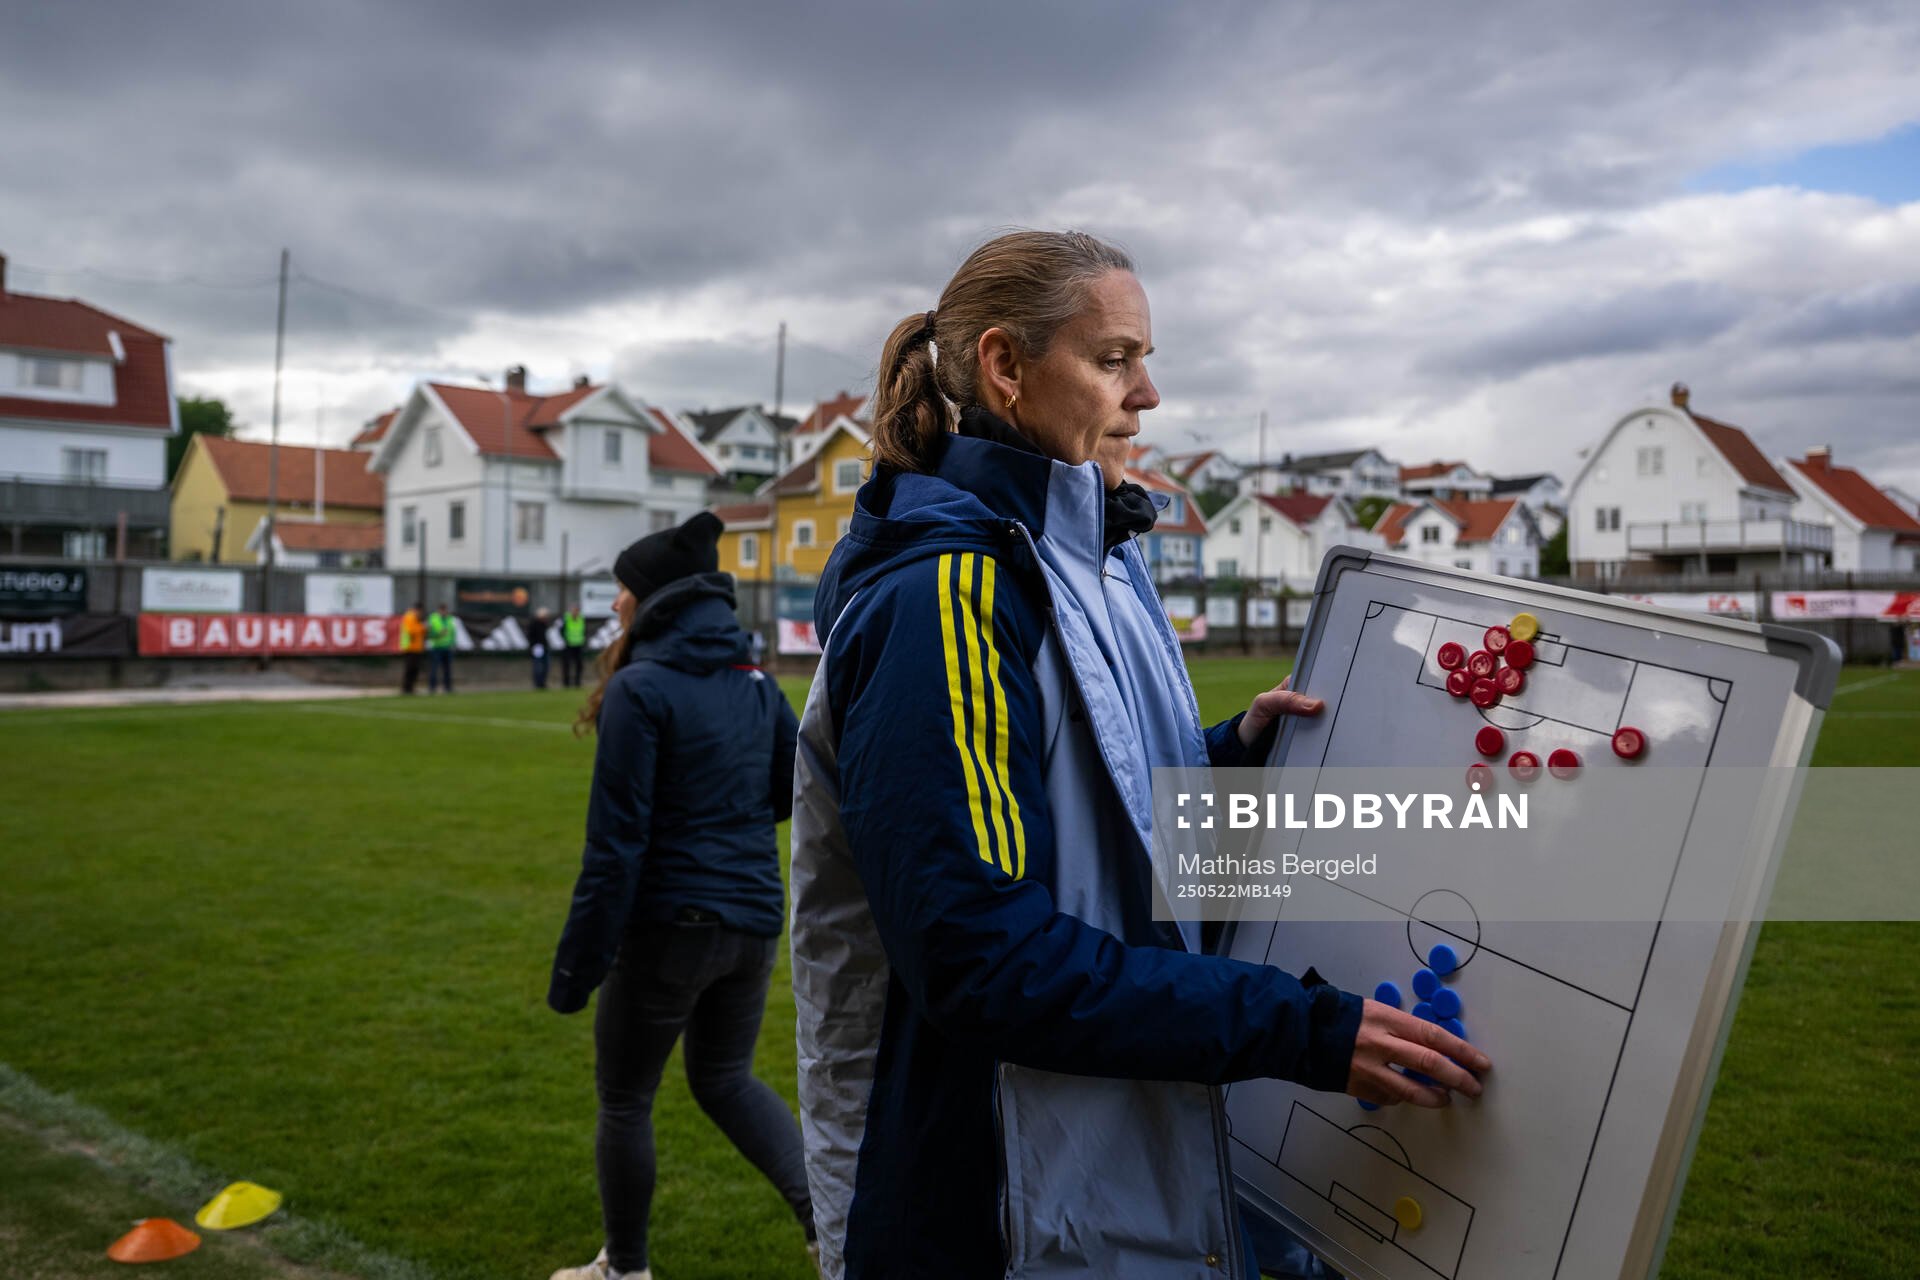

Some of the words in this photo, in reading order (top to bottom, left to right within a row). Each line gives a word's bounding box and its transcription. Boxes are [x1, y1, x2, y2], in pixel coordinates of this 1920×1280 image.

[0, 572, 67, 592] TUDIO
[69, 573, 83, 592] J
[169, 619, 388, 648] BAUHAUS
